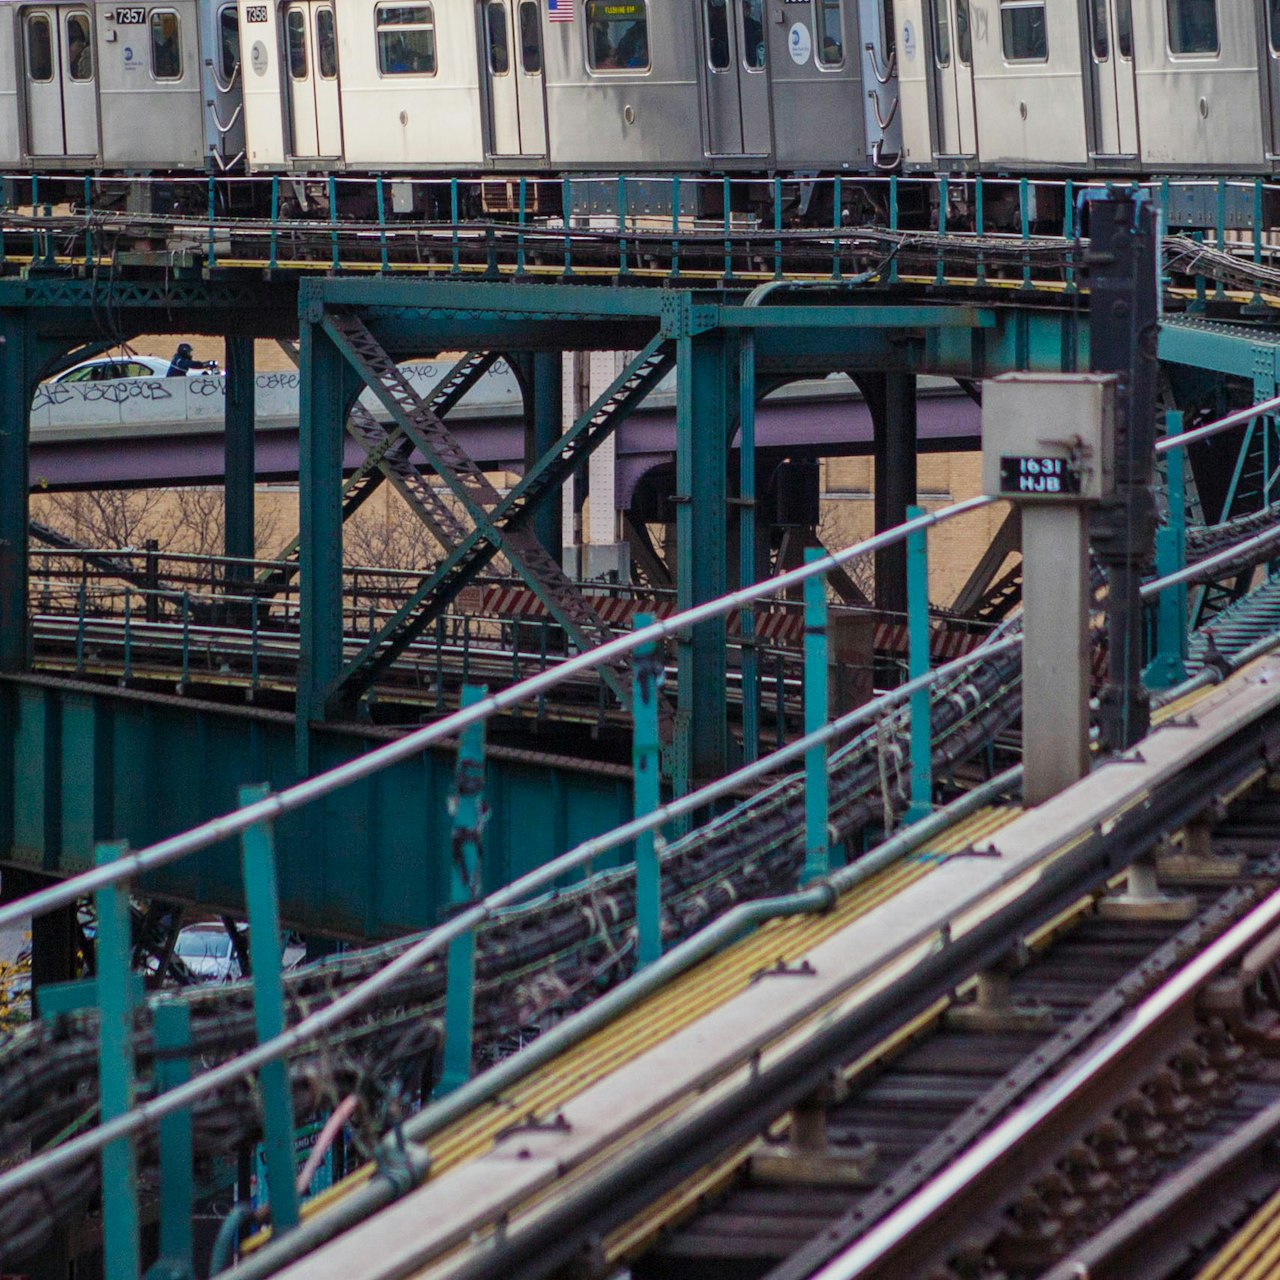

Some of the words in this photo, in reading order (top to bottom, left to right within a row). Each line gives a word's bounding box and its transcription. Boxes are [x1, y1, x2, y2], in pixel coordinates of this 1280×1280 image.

[117, 8, 145, 24] 7357
[247, 7, 267, 22] 7358
[1020, 458, 1061, 474] 1631
[1020, 476, 1061, 491] HJB
